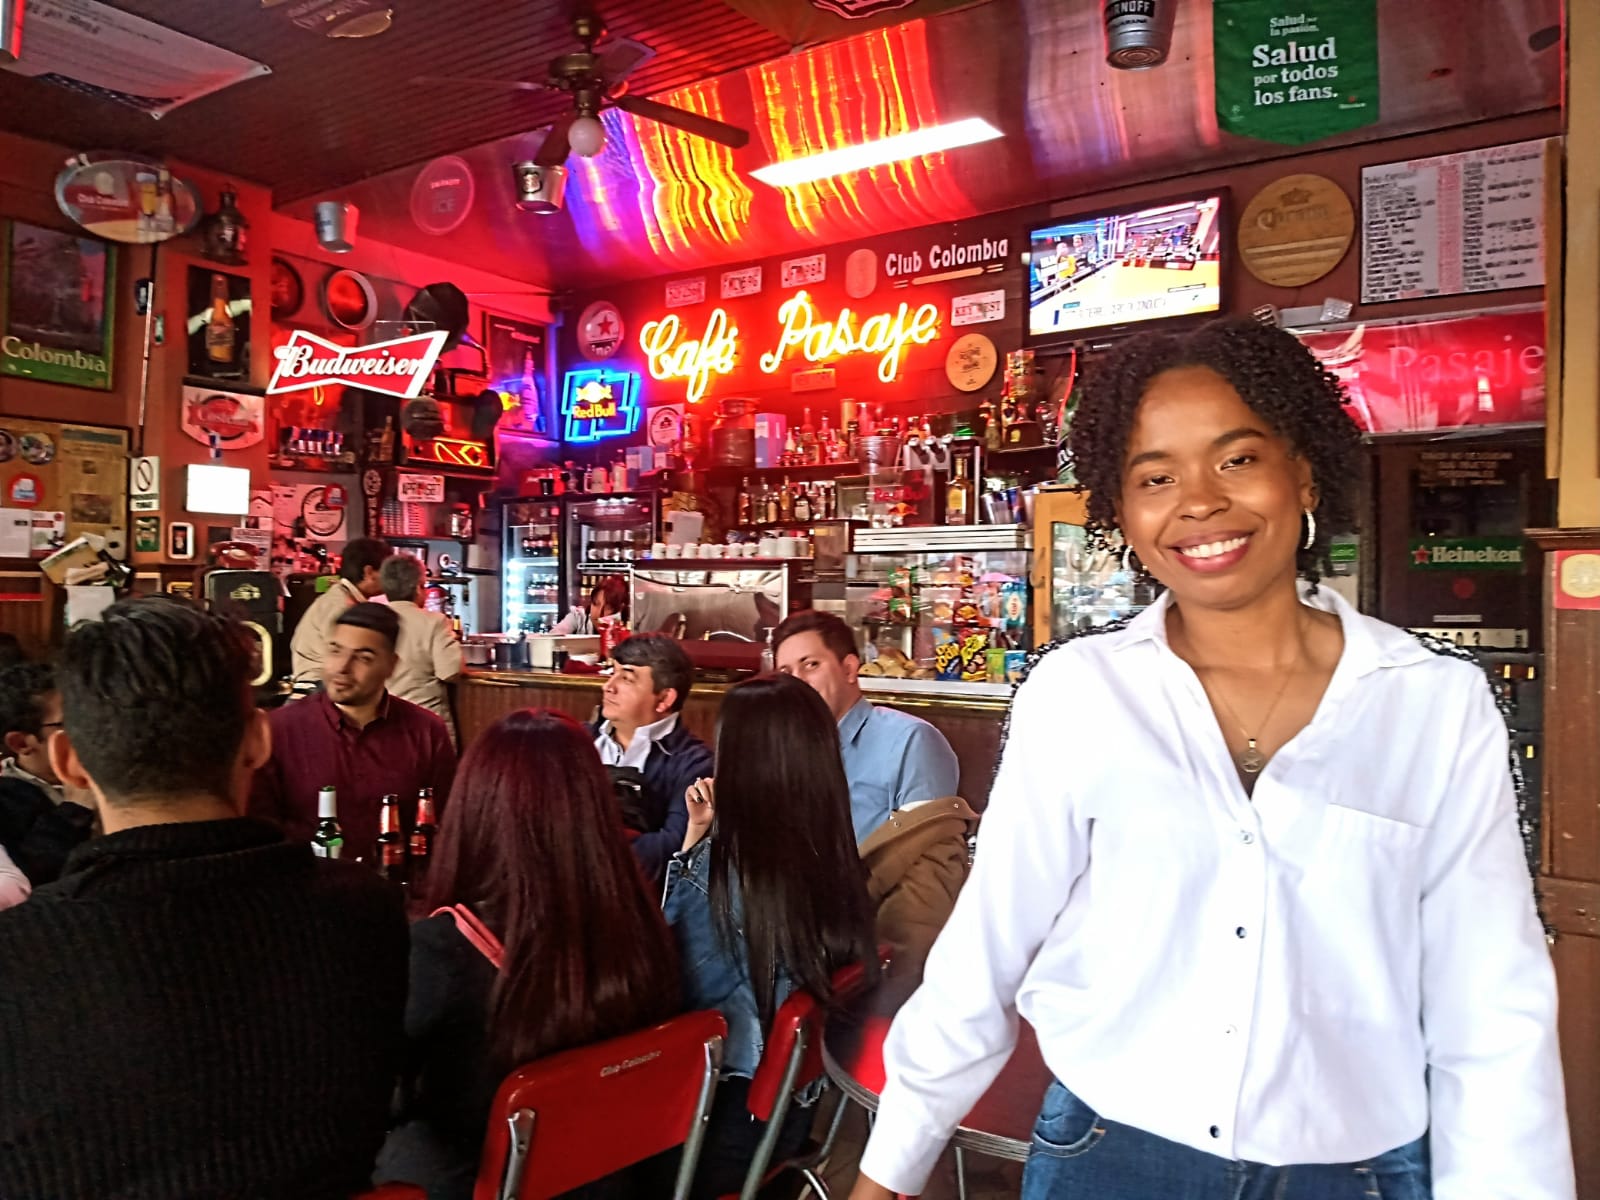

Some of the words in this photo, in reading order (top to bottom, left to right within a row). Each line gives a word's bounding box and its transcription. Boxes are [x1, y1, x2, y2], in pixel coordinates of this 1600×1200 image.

[1269, 13, 1305, 28] Salud
[1252, 37, 1337, 67] Salud
[1254, 74, 1278, 87] por
[1281, 64, 1338, 83] todos
[1254, 90, 1284, 106] los
[1288, 85, 1338, 102] fans.
[885, 251, 923, 277] Club
[929, 238, 1009, 269] Colombia
[2, 335, 106, 373] Colombia
[639, 307, 739, 403] Café
[759, 288, 940, 384] Pasaje
[273, 344, 427, 378] Budweiser
[1388, 333, 1545, 389] Pasaje
[573, 404, 595, 418] Red
[595, 402, 616, 417] Bull
[1432, 545, 1523, 563] Heineken
